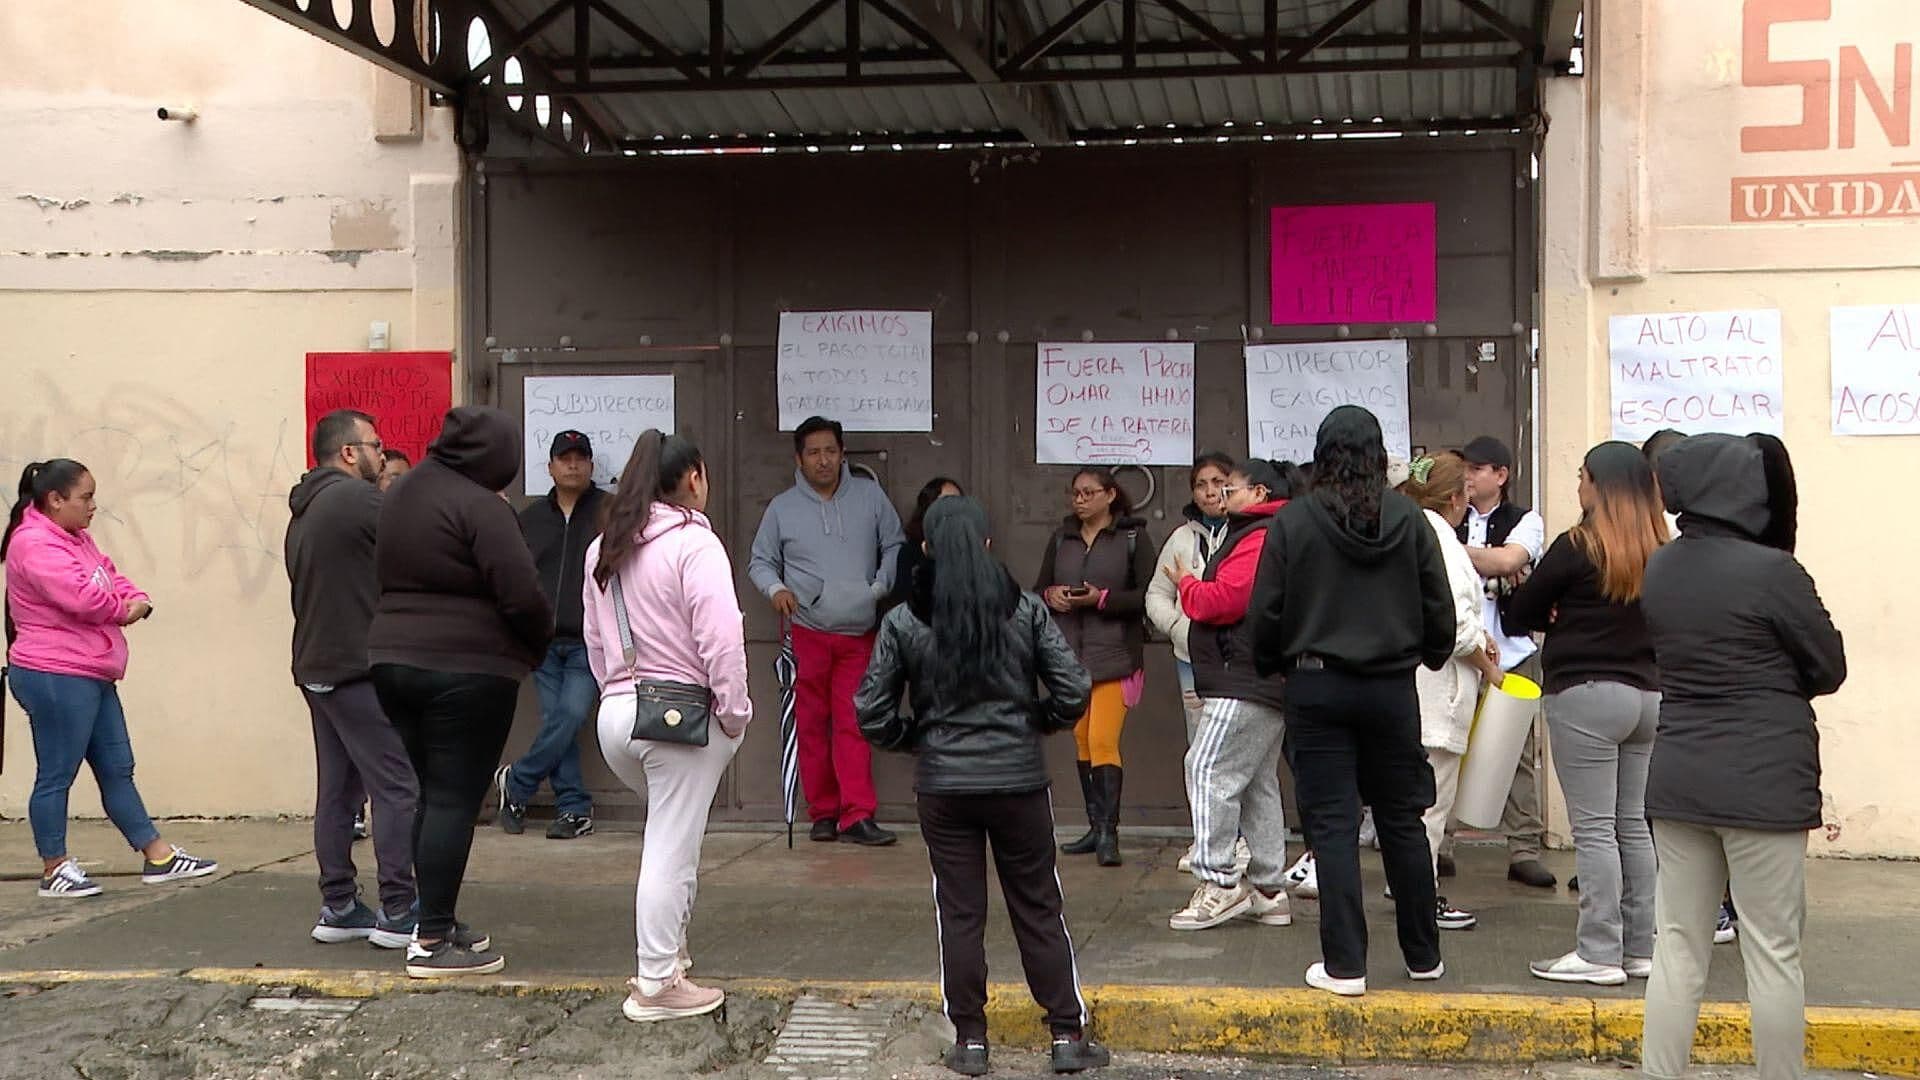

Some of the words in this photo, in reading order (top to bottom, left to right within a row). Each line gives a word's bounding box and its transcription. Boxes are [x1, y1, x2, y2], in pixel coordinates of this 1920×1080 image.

[1741, 179, 1920, 218] UNIDA
[802, 315, 910, 337] EXIGIMOS
[1638, 316, 1706, 345] ALTO
[1726, 315, 1766, 344] AL
[781, 343, 806, 359] EL
[1043, 348, 1124, 378] FUERA
[1256, 350, 1392, 375] DIRECTOR
[1620, 355, 1773, 382] MALTRATO
[1047, 382, 1111, 405] OMAR
[1270, 385, 1397, 408] EXIGIMOS
[1836, 385, 1920, 425] ACOS
[1619, 393, 1775, 424] ESCOLAR
[1047, 417, 1081, 434] DE
[1091, 416, 1114, 433] LA
[1121, 416, 1191, 436] RATERA
